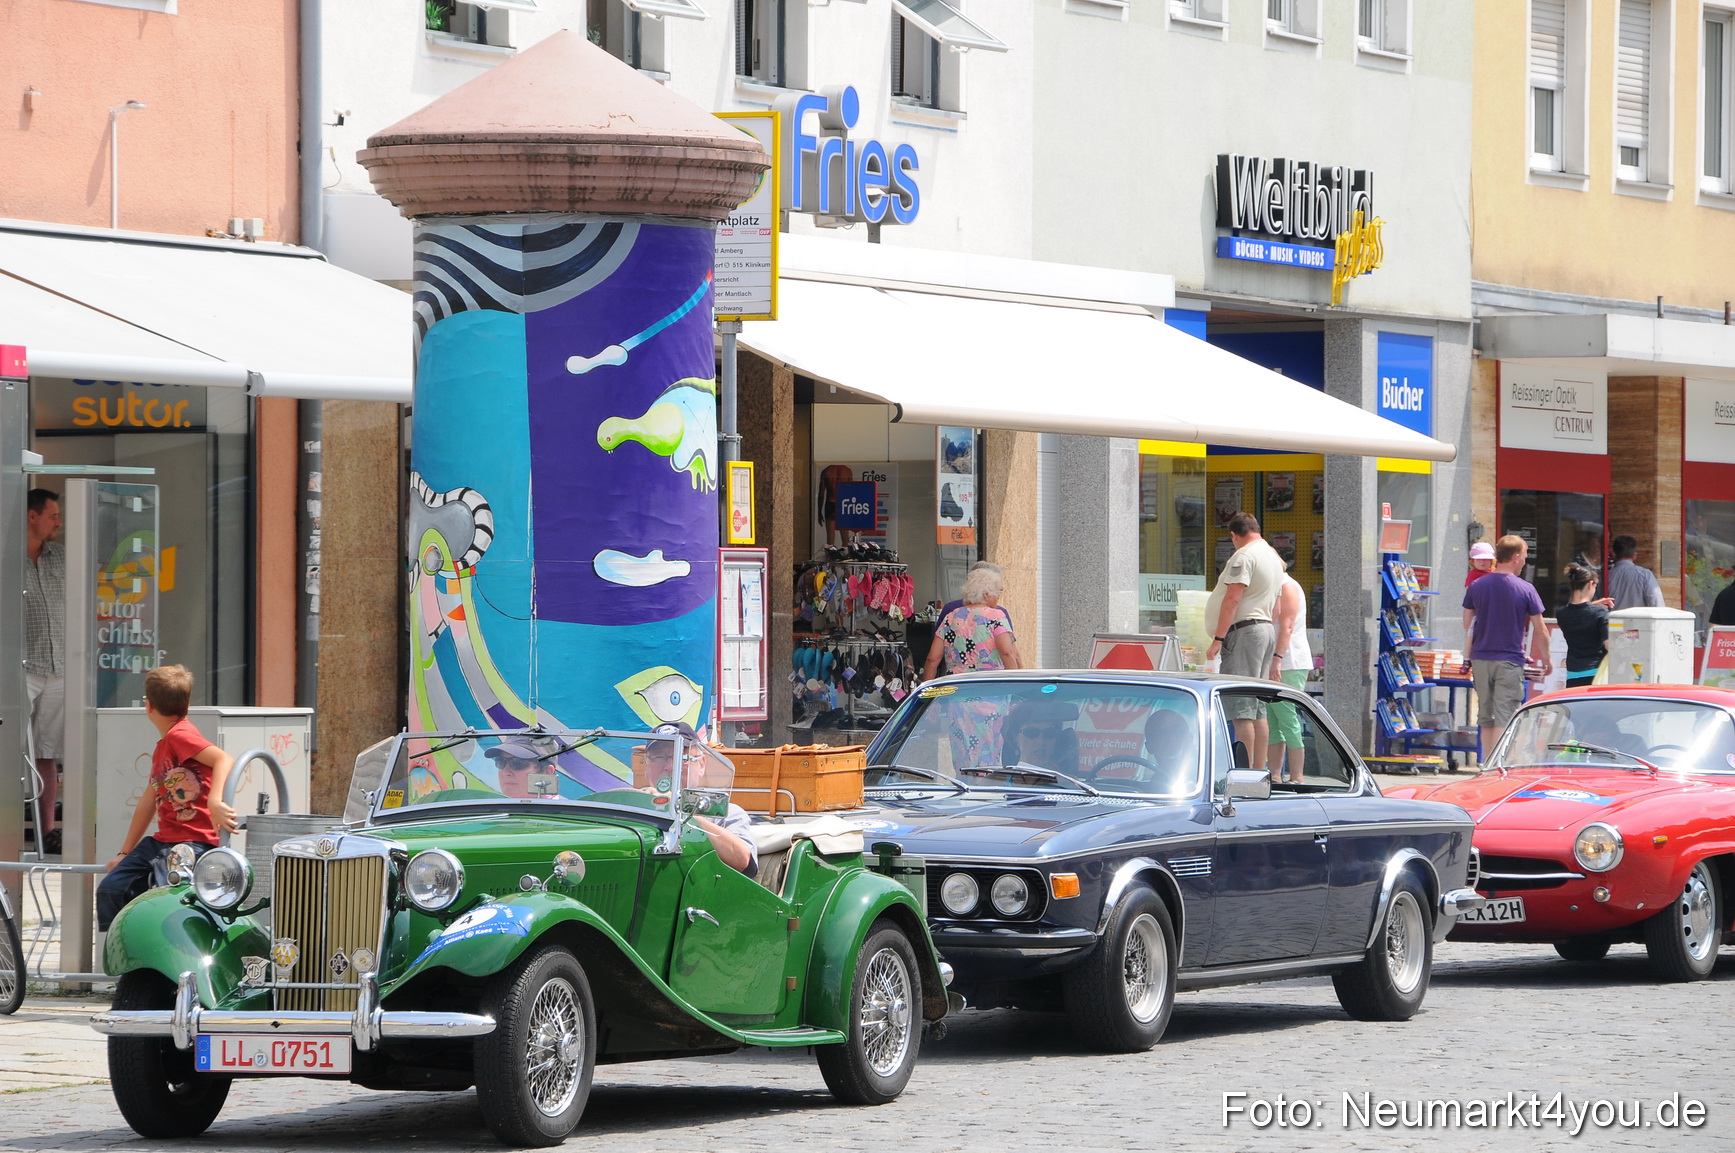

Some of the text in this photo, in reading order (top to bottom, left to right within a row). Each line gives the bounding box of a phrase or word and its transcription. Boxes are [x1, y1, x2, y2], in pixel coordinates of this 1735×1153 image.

[1217, 153, 1374, 243] Weltbild
[716, 216, 760, 228] rktplatz
[1235, 242, 1326, 269] BÜCHER MUSIK VIDEOS
[1382, 377, 1424, 411] Bücher
[1512, 383, 1577, 407] Reissinger Optik
[1555, 416, 1593, 434] CENTRUM
[97, 599, 146, 619] utor
[1716, 638, 1735, 648] Frisc
[1719, 648, 1726, 657] 5
[1088, 696, 1151, 713] STOP
[1103, 739, 1137, 749] Schuhe
[386, 790, 404, 798] ADAC
[459, 915, 474, 926] 4
[444, 933, 465, 946] Allianz
[201, 1056, 207, 1064] D
[222, 1040, 334, 1068] LL 0751
